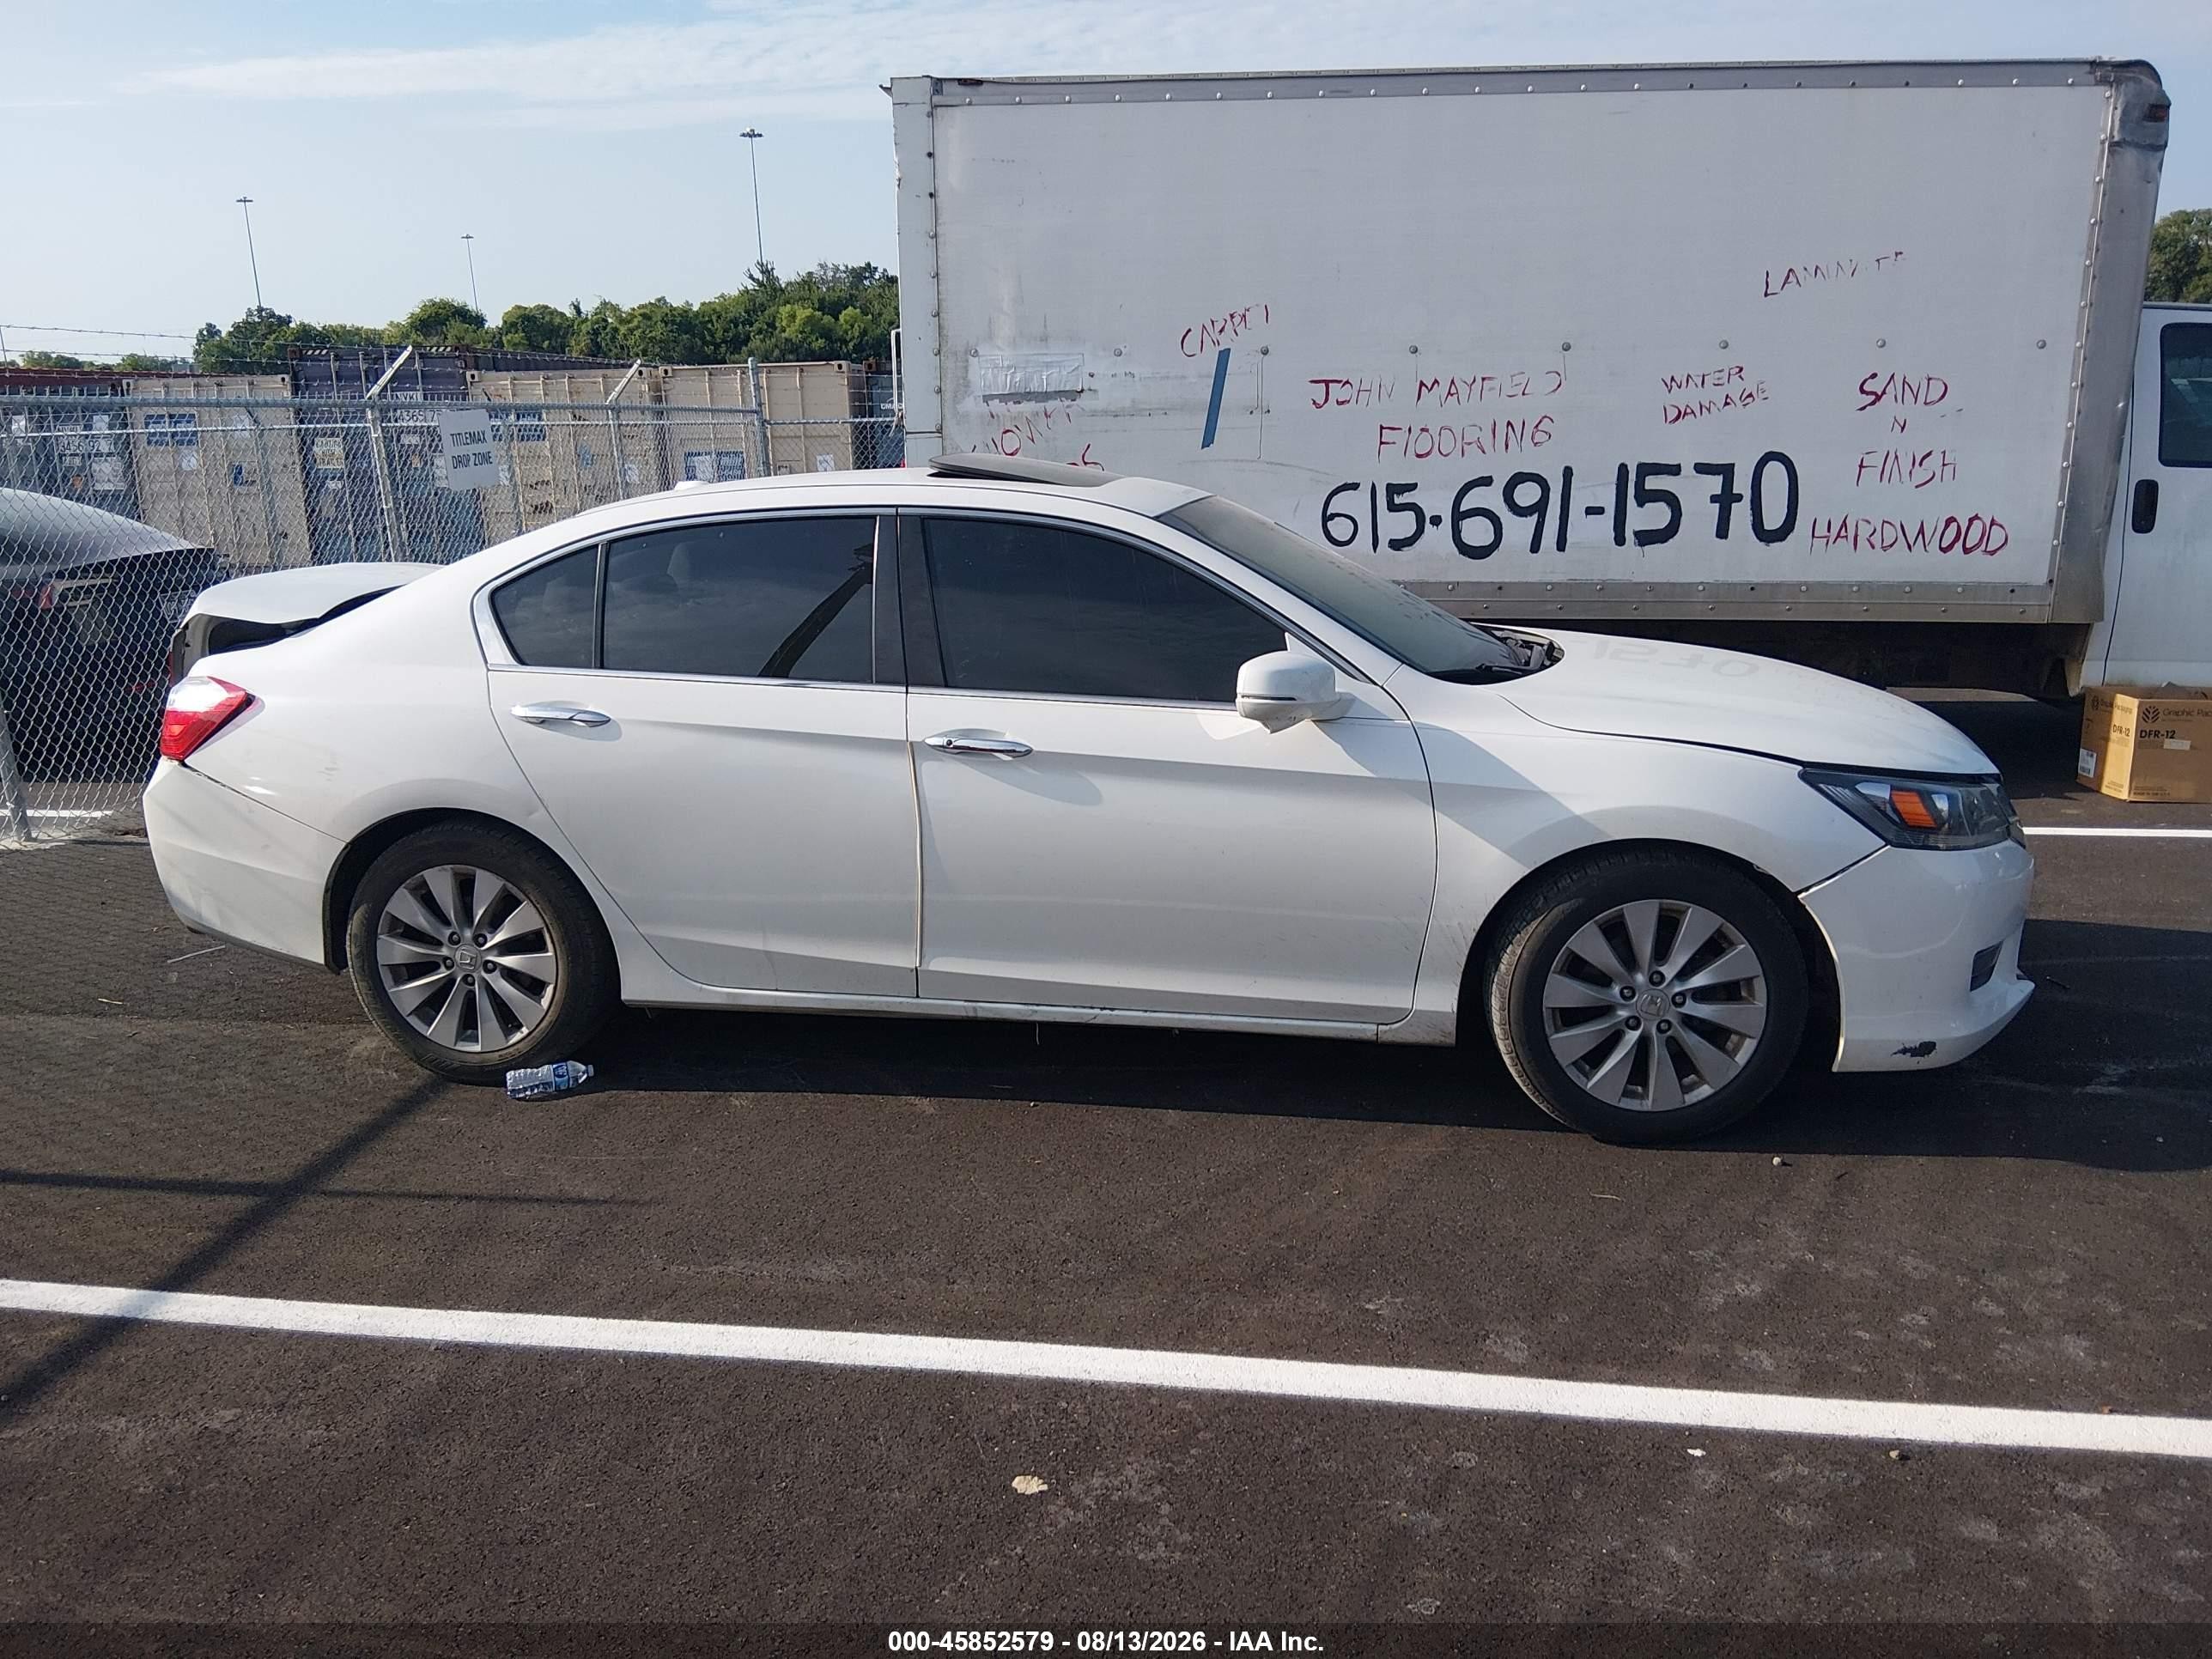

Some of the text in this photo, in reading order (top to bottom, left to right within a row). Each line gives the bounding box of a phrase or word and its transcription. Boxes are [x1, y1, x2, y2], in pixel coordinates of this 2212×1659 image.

[1308, 370, 1563, 409] JOHN MAYFIELD
[1661, 365, 1745, 394] WATER
[1855, 372, 1948, 411] SAND
[1662, 380, 1769, 424] DAMAGE
[449, 429, 488, 447] TITLEMAX
[1891, 416, 1907, 433] N
[451, 451, 493, 470] DROP ZONE
[1856, 447, 1958, 489] FINISH
[1809, 514, 2010, 556] HARDWOOD
[2112, 724, 2130, 738] DFR-12
[2139, 729, 2176, 739] DFR-12
